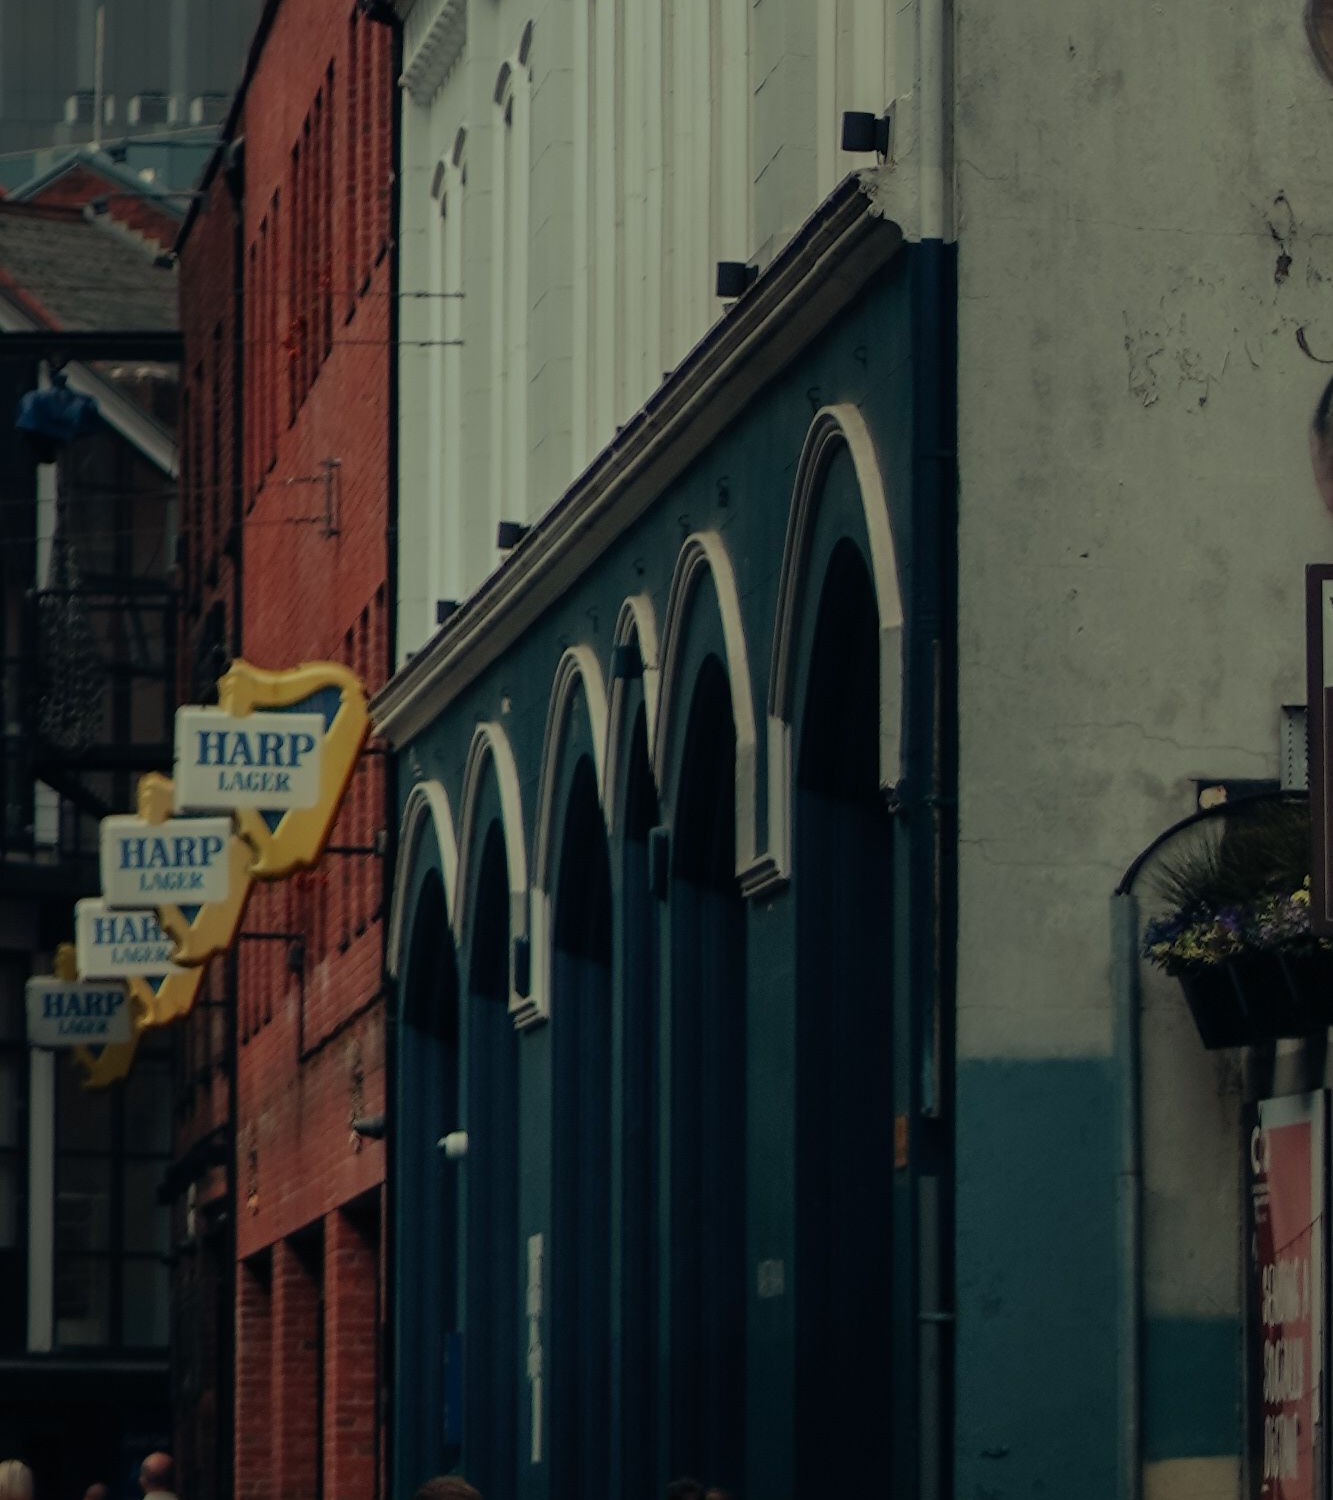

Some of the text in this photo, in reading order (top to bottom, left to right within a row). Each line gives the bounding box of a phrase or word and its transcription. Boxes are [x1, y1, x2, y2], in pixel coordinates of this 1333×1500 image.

[196, 730, 315, 767] HARP
[218, 771, 290, 793] LAGER
[119, 835, 224, 869] HARP
[139, 872, 204, 892] LAGER
[43, 992, 124, 1018] HARP
[58, 1018, 107, 1034] LAGER
